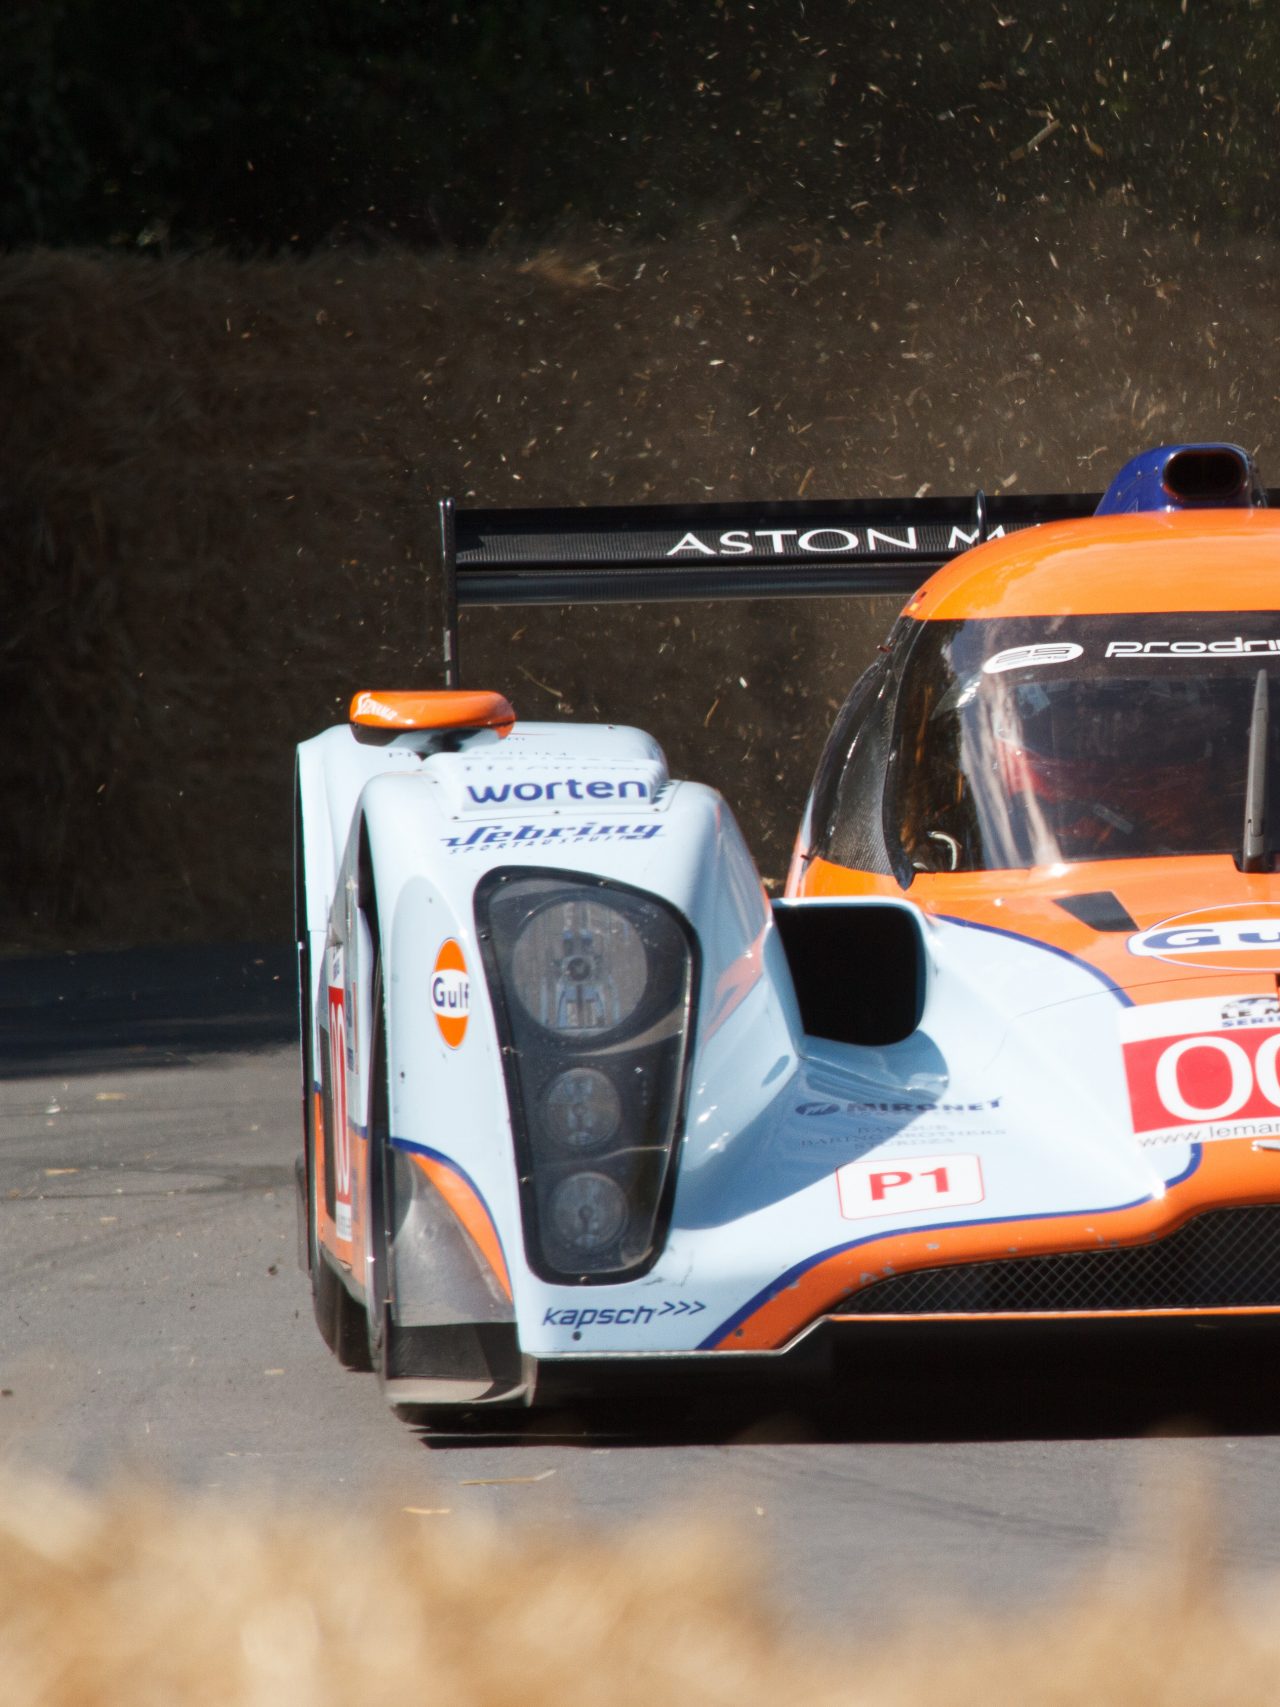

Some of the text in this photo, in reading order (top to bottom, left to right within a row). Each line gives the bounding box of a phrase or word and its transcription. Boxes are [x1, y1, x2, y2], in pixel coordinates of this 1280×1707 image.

[666, 527, 917, 556] ASTON
[467, 778, 648, 804] worten
[440, 821, 665, 847] Sebring
[432, 976, 469, 1009] Gulf
[1221, 1010, 1251, 1020] LE
[847, 1097, 1002, 1112] MIRONET
[869, 1167, 949, 1201] P1
[542, 1306, 653, 1329] kapsch
